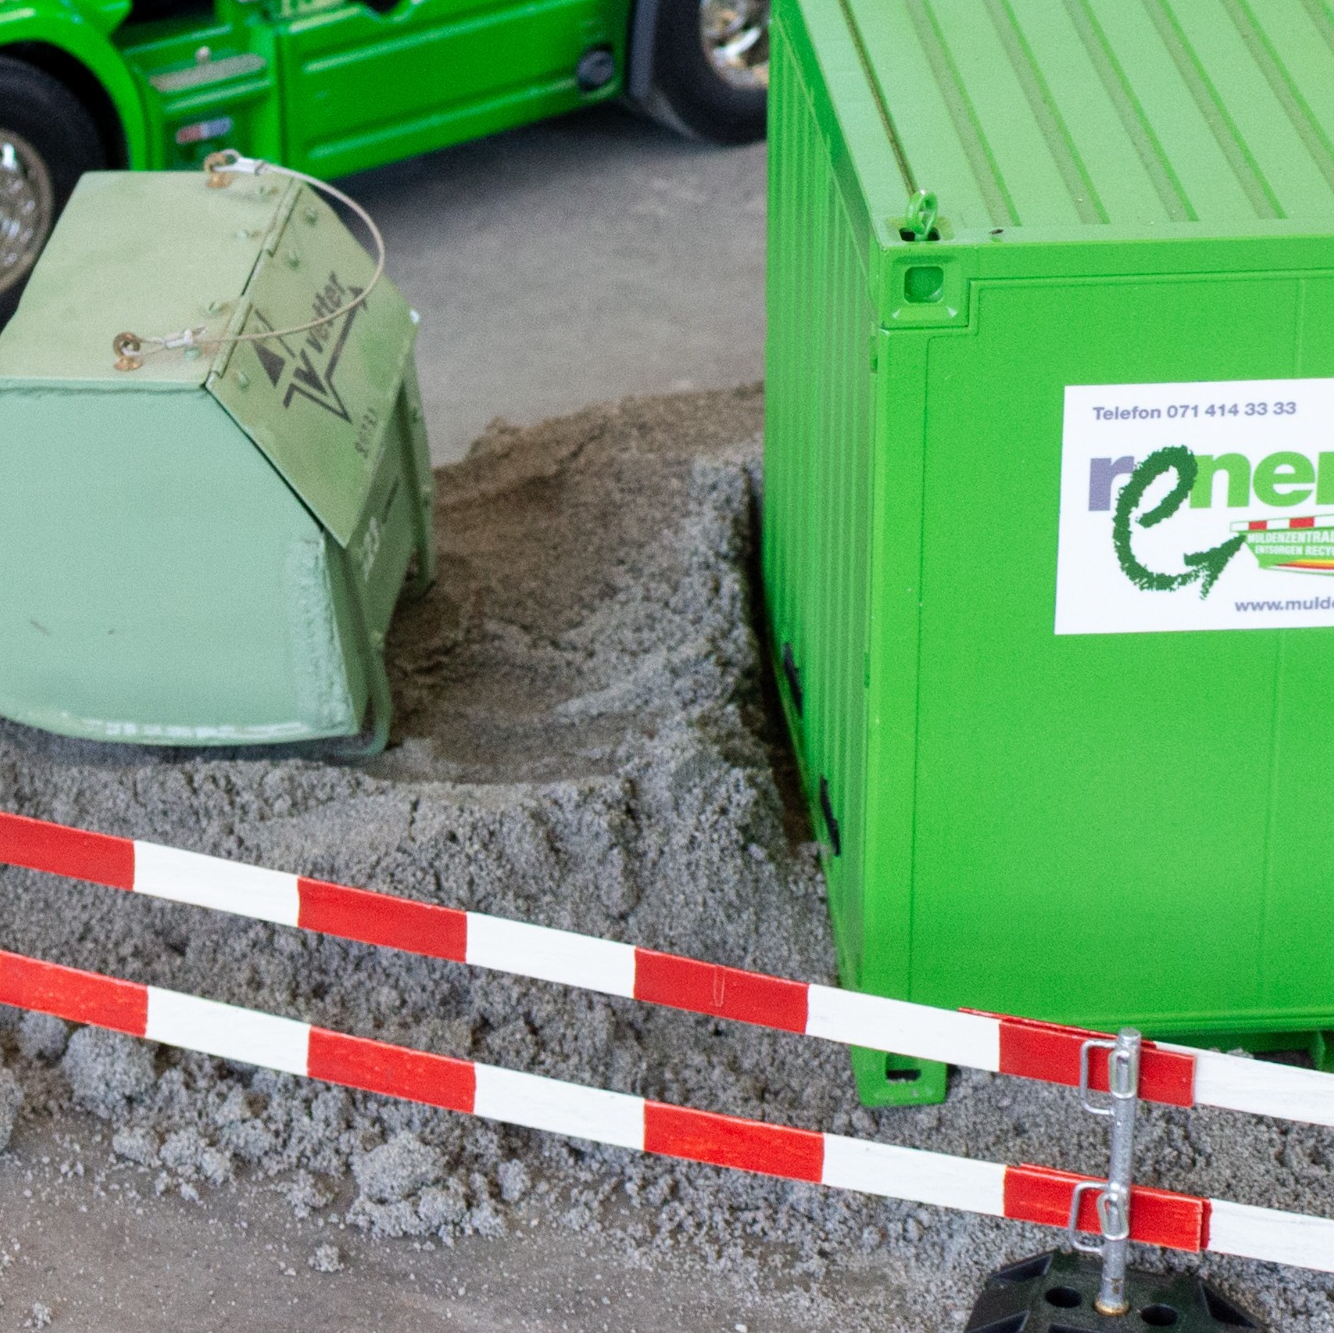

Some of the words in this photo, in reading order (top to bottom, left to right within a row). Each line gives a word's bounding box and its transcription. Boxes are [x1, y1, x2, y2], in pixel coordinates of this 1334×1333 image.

[1092, 405, 1162, 421] Telefon
[1166, 404, 1200, 419] 071
[1204, 403, 1240, 417] 414
[1244, 402, 1268, 416] 33
[1272, 401, 1297, 415] 33
